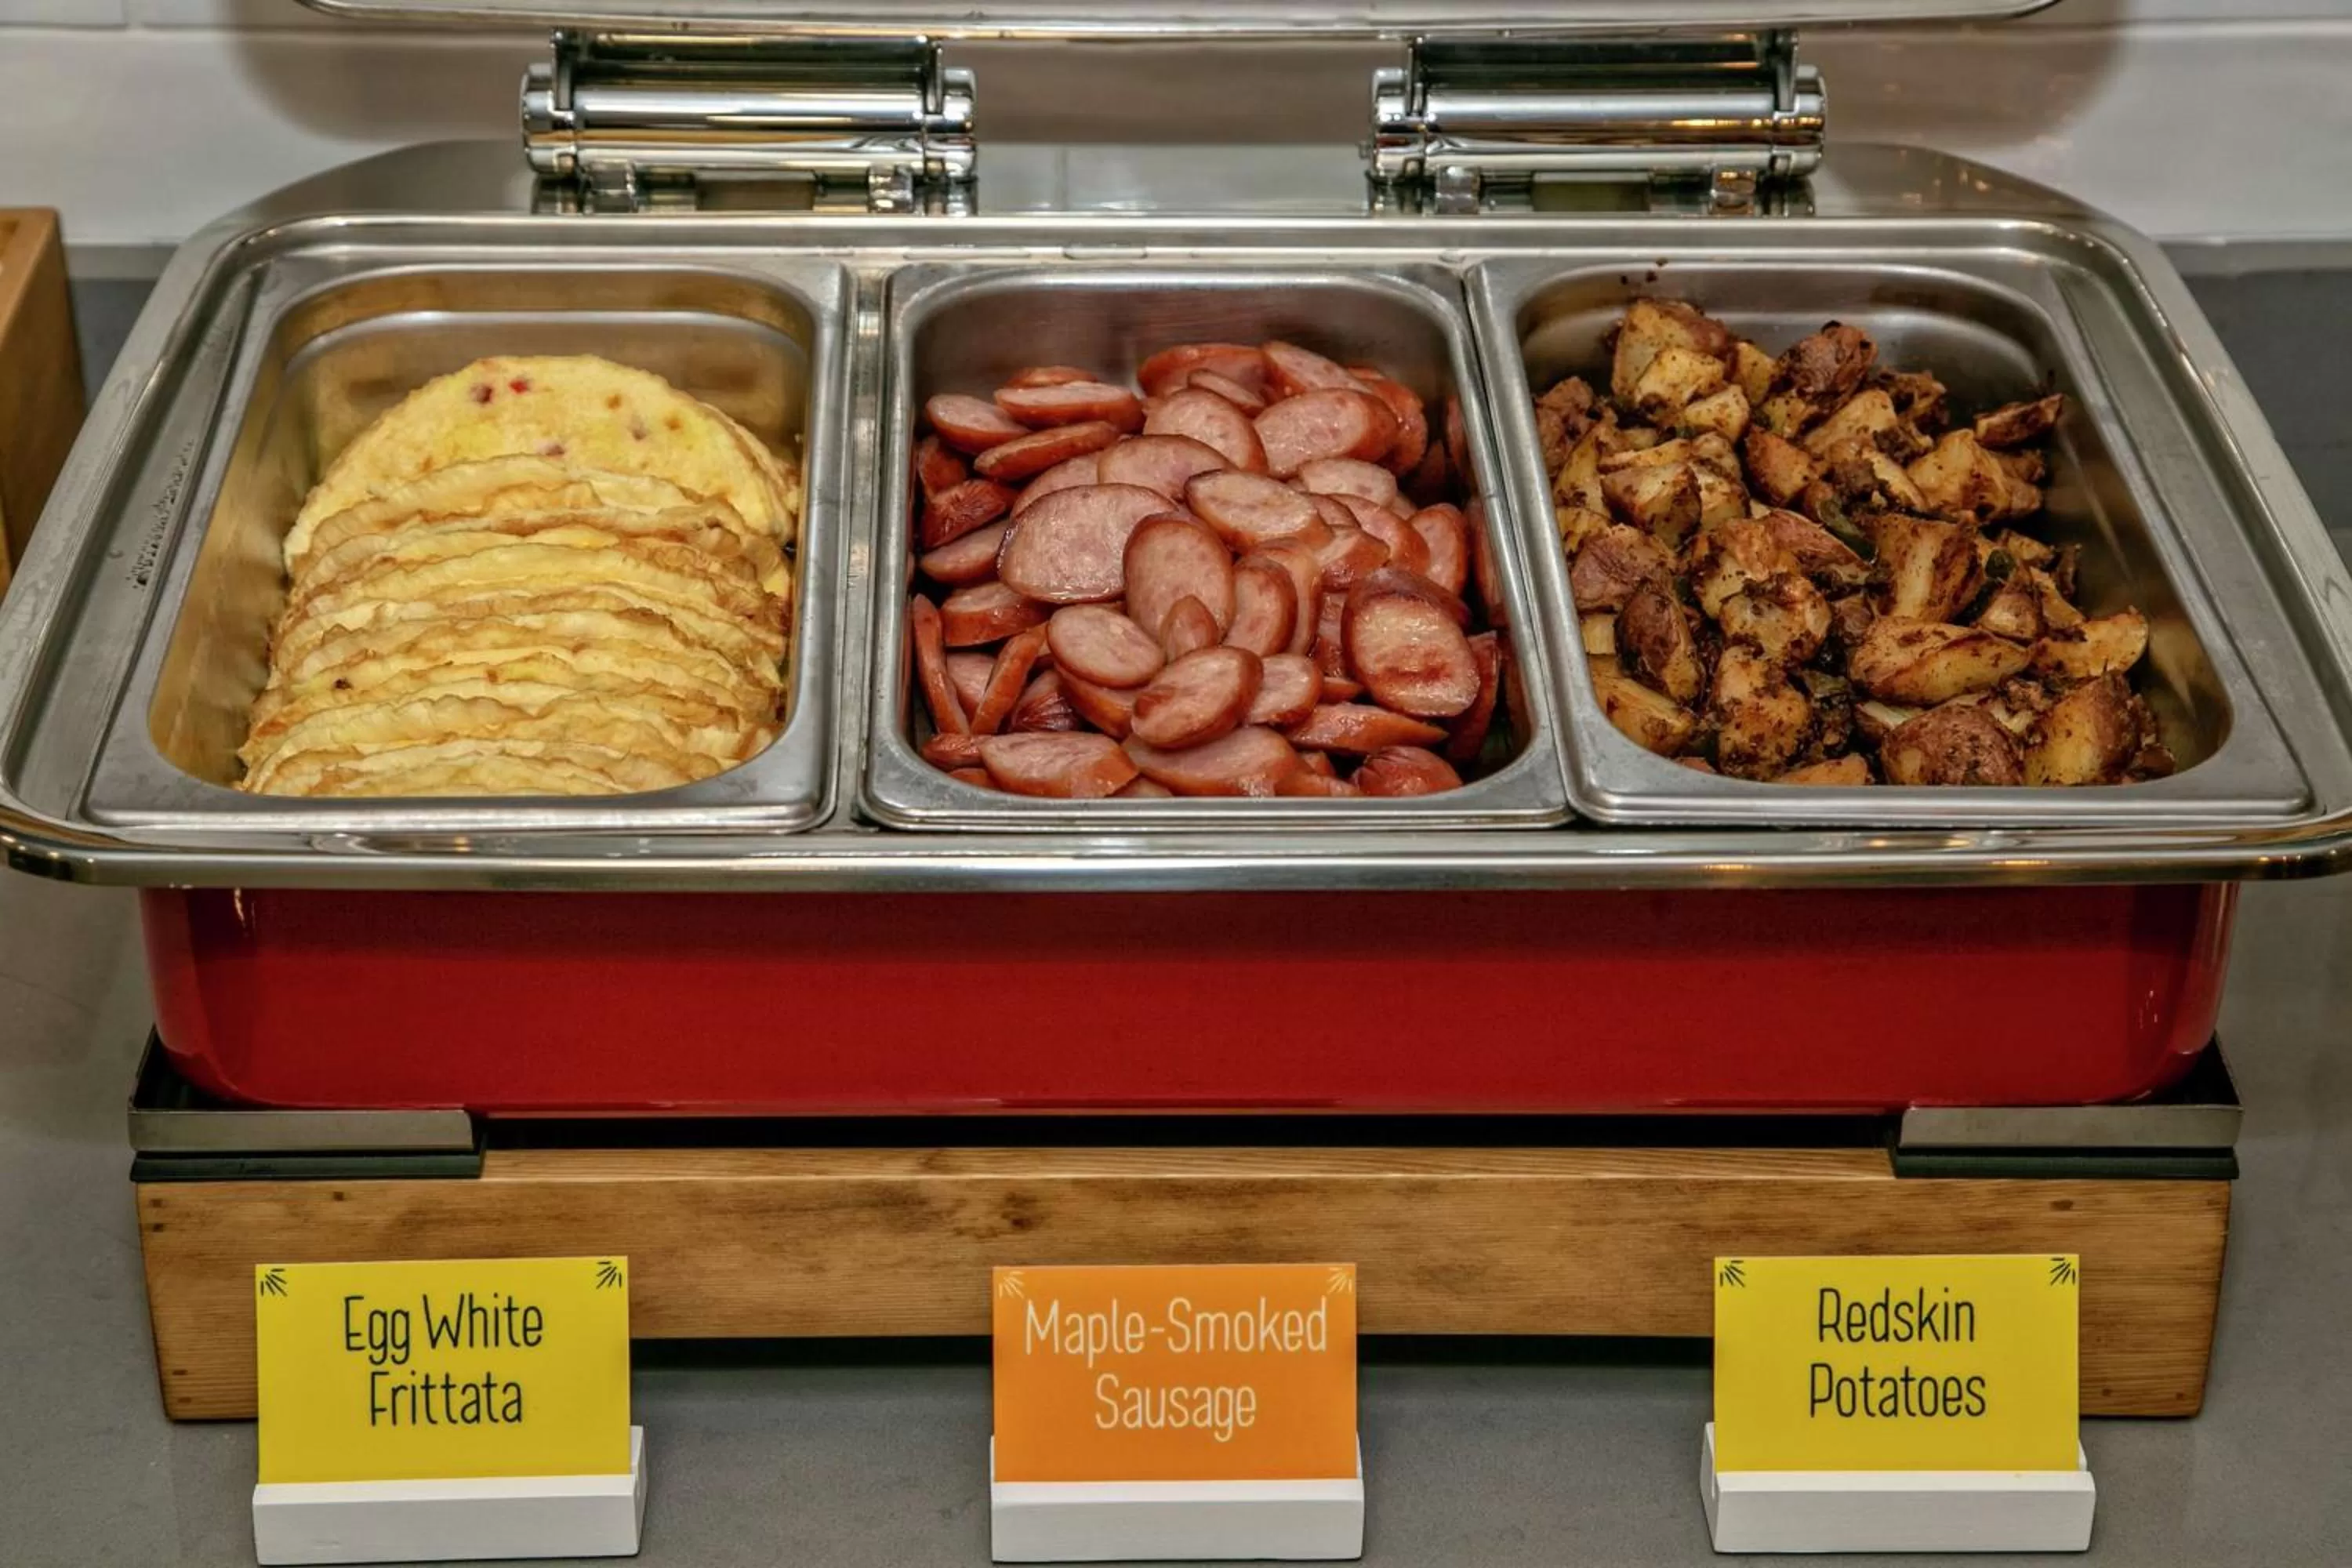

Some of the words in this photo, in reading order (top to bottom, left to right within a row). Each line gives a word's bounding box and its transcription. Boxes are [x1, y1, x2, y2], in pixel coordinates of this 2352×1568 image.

[343, 1294, 411, 1366] Egg
[422, 1292, 544, 1350] White
[1025, 1295, 1327, 1369] Maple-Smoked
[1817, 1287, 1976, 1343] Redskin
[370, 1370, 523, 1427] Frittata
[1094, 1372, 1258, 1443] Sausage
[1809, 1362, 1987, 1418] Potatoes
